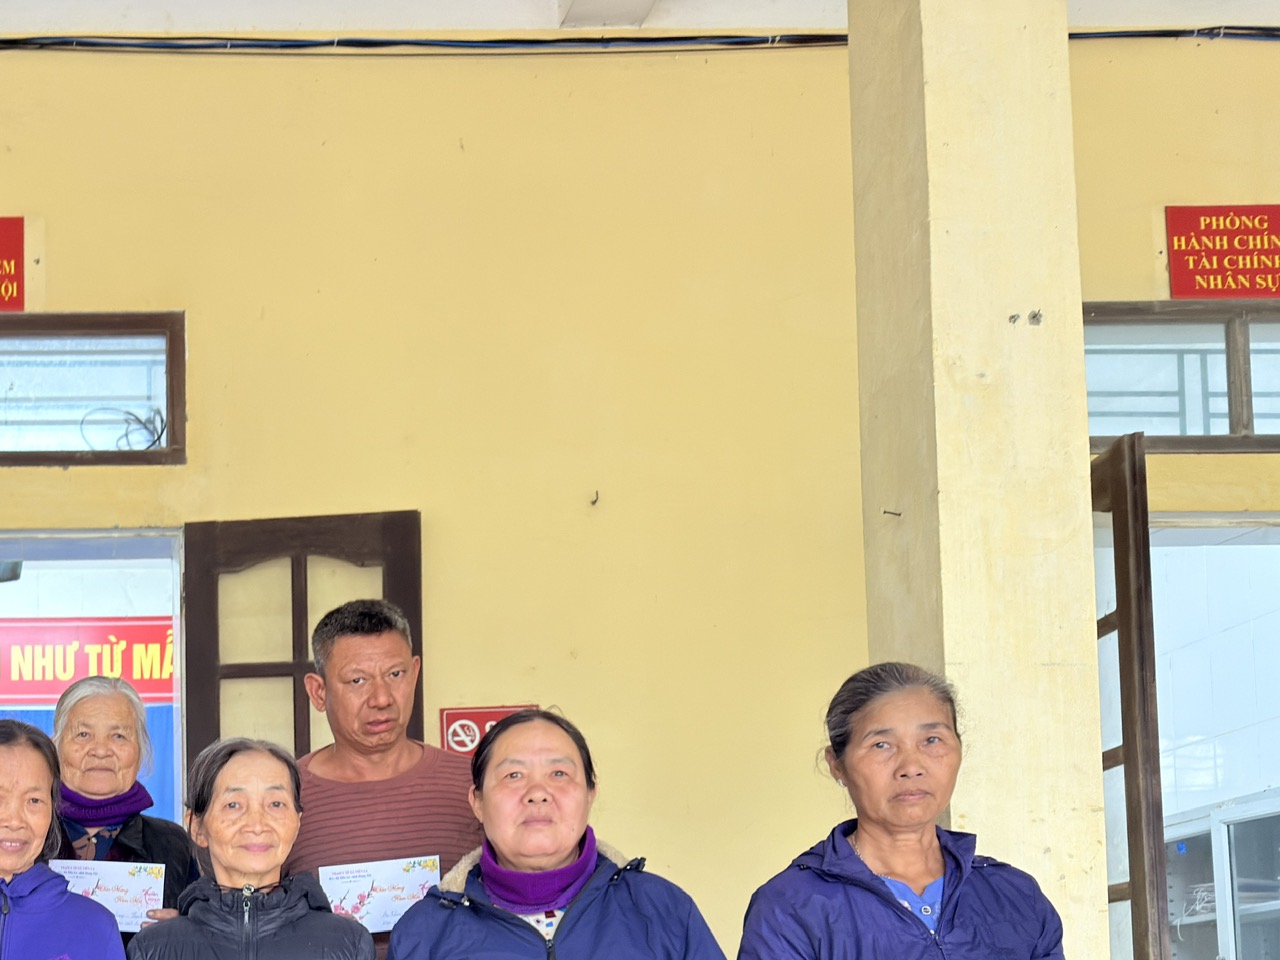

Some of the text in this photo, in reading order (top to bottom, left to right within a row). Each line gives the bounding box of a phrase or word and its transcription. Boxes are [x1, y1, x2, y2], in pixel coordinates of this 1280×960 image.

[1200, 212, 1269, 231] PHÒNG
[1173, 232, 1229, 250] HÀNH
[1184, 252, 1218, 269] TÀI
[1195, 271, 1251, 290] NHÂN
[10, 640, 80, 681] NHƯ
[84, 634, 127, 679] TỪ
